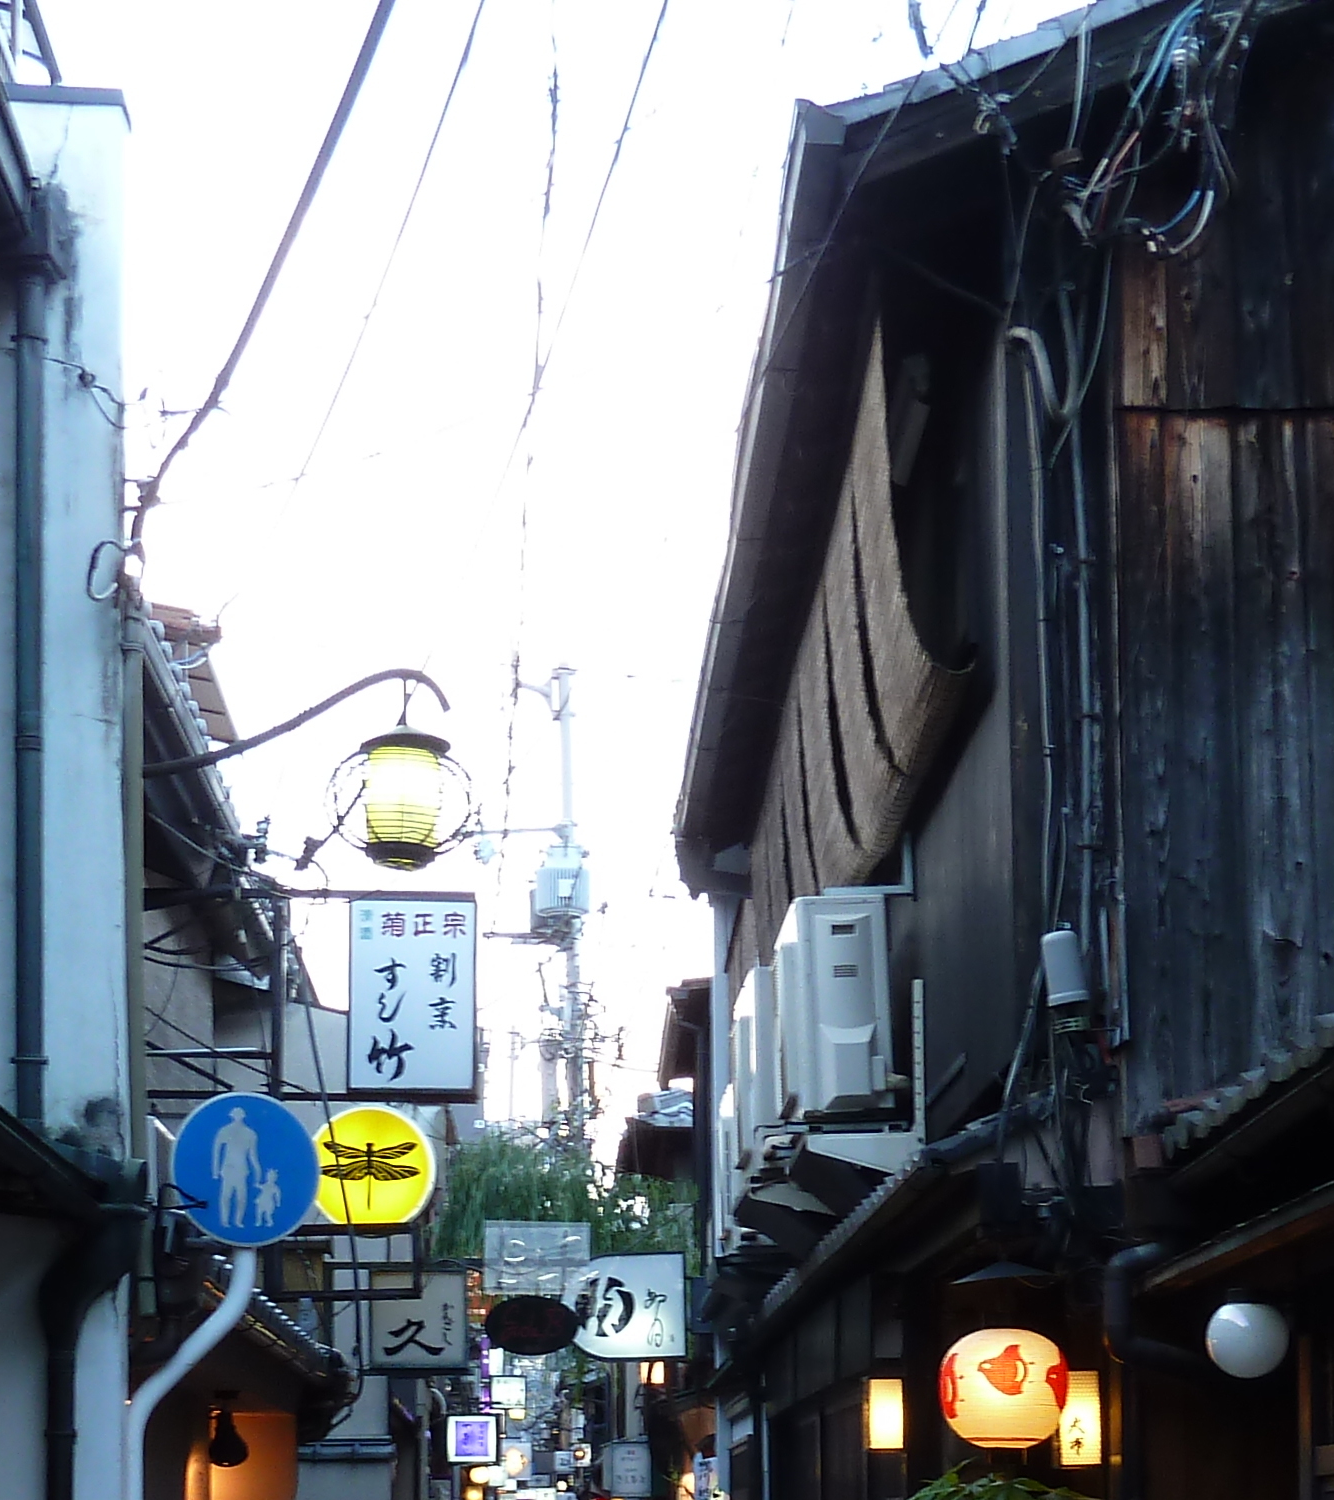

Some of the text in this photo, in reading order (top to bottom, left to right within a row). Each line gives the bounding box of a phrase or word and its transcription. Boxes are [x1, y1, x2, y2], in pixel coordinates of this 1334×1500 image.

[380, 911, 467, 939] 菊正宗
[367, 957, 415, 1082] すし竹
[428, 952, 459, 1030] 割烹
[383, 1318, 443, 1356] 久
